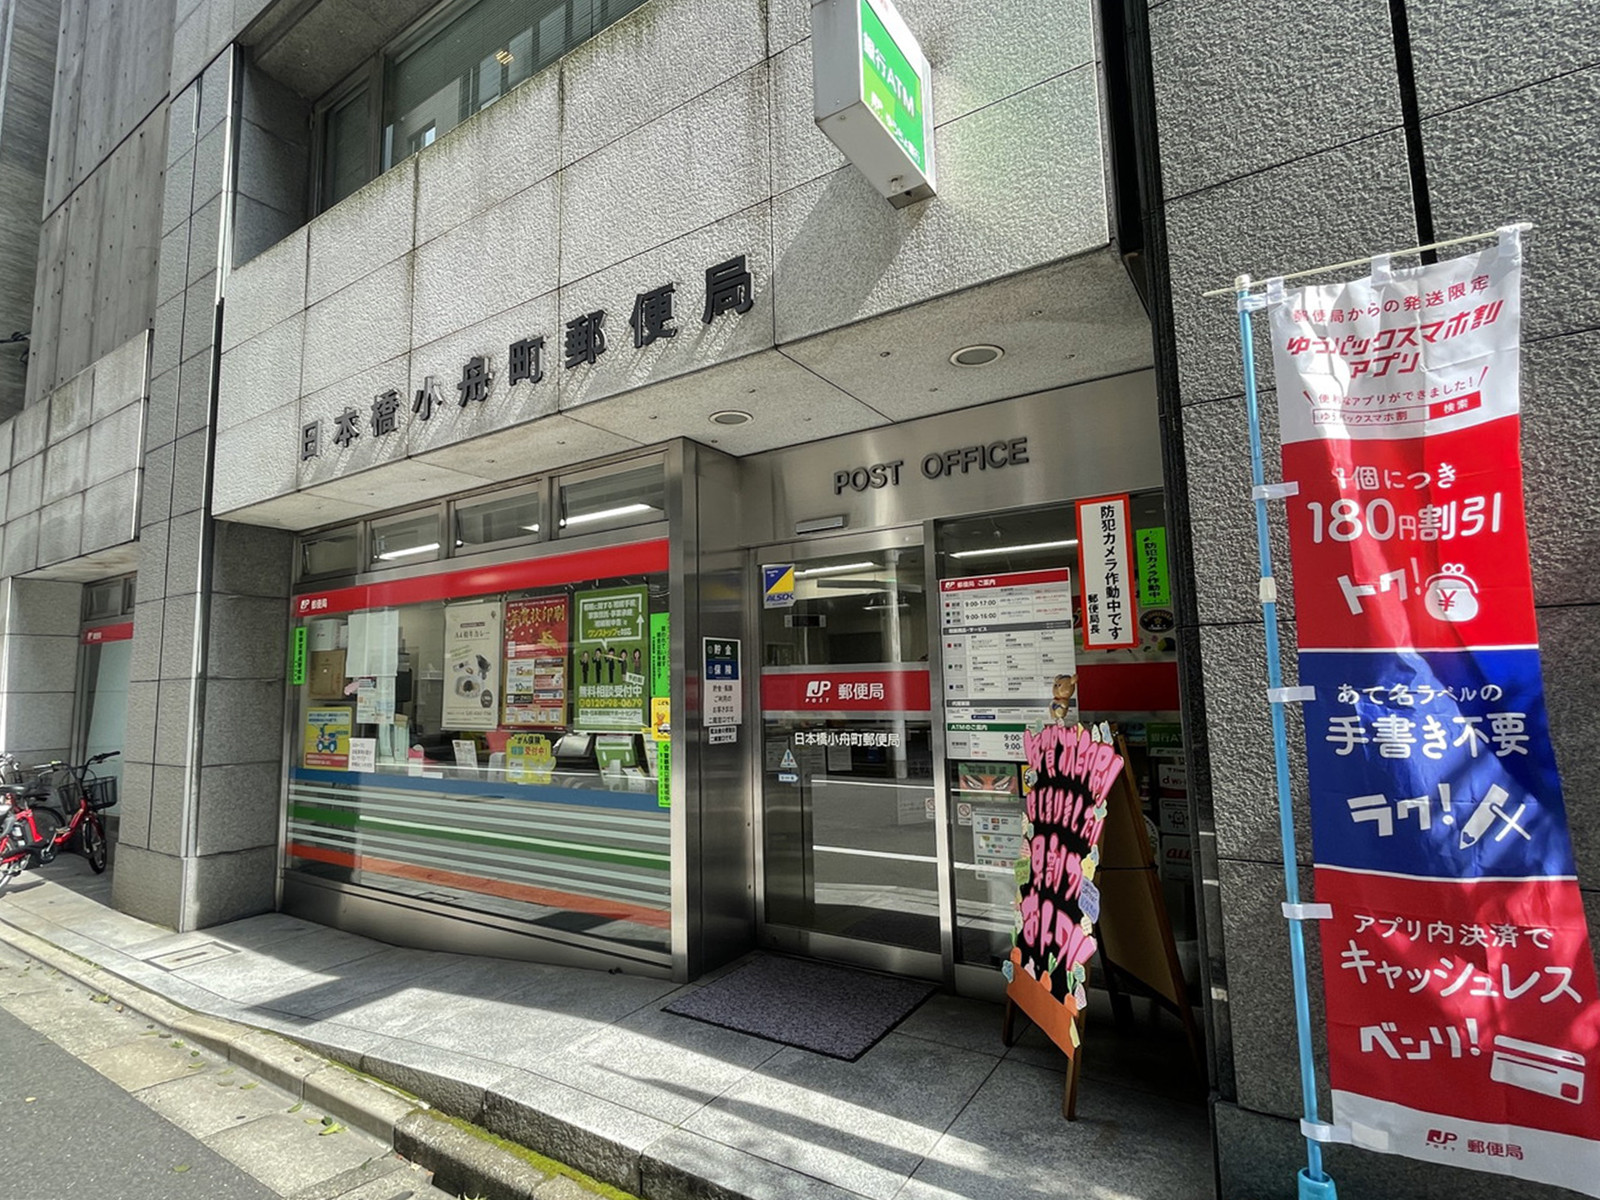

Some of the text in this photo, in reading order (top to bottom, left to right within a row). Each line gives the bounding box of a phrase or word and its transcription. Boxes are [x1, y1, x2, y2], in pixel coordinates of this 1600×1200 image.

[1292, 274, 1490, 323] 郵便局からの発送限定
[1286, 299, 1504, 356] ゆうパックスマホ割
[301, 254, 755, 461] 日本橋小舟町郵便局
[1350, 352, 1420, 379] アプリ
[1443, 398, 1469, 414] 検索
[833, 437, 1029, 495] POST OFFICE
[1332, 462, 1457, 490] 1個につき
[1306, 492, 1502, 544] 180円割引
[1100, 505, 1122, 640] 防犯カメラ作動中です
[1337, 557, 1422, 615] トク!
[1088, 594, 1100, 634] 郵便局長
[838, 682, 885, 701] 郵便局
[1337, 683, 1503, 706] あて名ラベルの
[794, 731, 901, 748] 日本橋小舟町郵便局
[1325, 711, 1530, 760] 手書き不要
[1347, 783, 1454, 838] ラク!
[1354, 914, 1555, 949] アプリ内決済で
[1341, 939, 1583, 1004] キャッシュレス
[1359, 1017, 1481, 1060] ベンリ!
[1467, 1139, 1524, 1161] 郵便局
